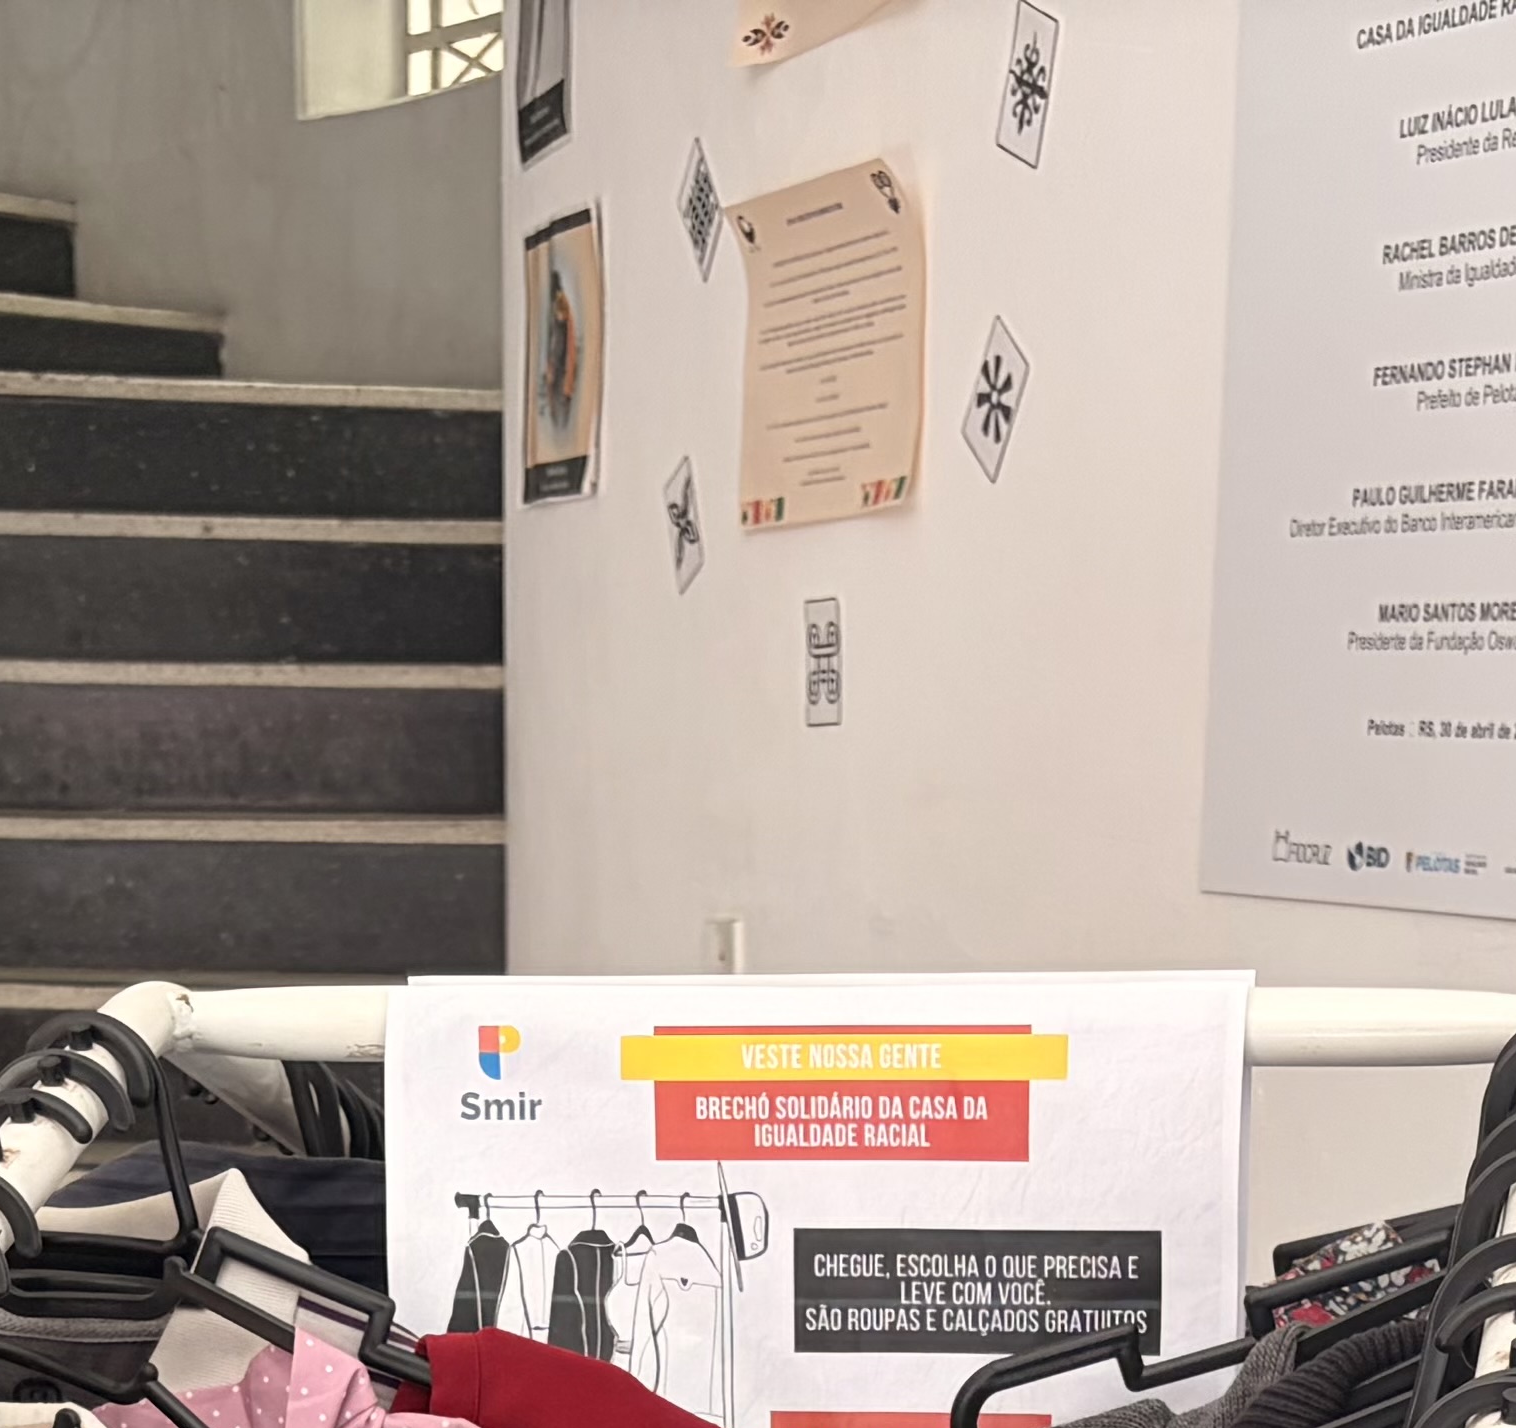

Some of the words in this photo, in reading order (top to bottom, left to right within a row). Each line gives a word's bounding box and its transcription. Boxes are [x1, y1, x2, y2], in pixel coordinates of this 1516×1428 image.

[1357, 23, 1394, 49] CASA
[1396, 18, 1415, 40] DA
[1418, 0, 1498, 35] IGUALDADE
[1399, 114, 1430, 138] LUIZ
[1431, 104, 1479, 133] INÁCIO
[1416, 136, 1480, 165] Presidente
[1484, 132, 1499, 153] da
[1382, 238, 1435, 265] RACHEL
[1438, 228, 1496, 256] BARROS
[1399, 268, 1444, 291] Ministra
[1446, 265, 1461, 285] da
[1373, 360, 1445, 387] FERNANDO
[1447, 353, 1512, 379] STEPHAN
[1416, 388, 1462, 411] Prefeito
[1464, 386, 1480, 407] de
[1352, 486, 1397, 508] PAULO
[1398, 481, 1475, 505] GUILHERME
[1289, 518, 1326, 538] Diretor
[1328, 516, 1381, 537] Executivo
[1384, 515, 1398, 534] do
[1400, 513, 1437, 533] Banco
[1378, 602, 1420, 623] MARIO
[1422, 601, 1476, 622] SANTOS
[1347, 631, 1406, 651] Presidente
[1409, 631, 1424, 651] da
[1426, 630, 1485, 655] Fundação
[741, 1043, 804, 1070] VESTE
[808, 1043, 874, 1070] NOSSA
[879, 1042, 943, 1069] GENTE
[459, 1091, 543, 1121] Smir
[695, 1092, 770, 1120] BRECHÓ
[775, 1091, 874, 1120] SOLIDÁRIO
[878, 1096, 903, 1120] DA
[908, 1095, 959, 1120] CASA
[963, 1095, 989, 1120] DA
[754, 1123, 859, 1148] IGUALDADE
[864, 1123, 931, 1148] RACIAL
[813, 1253, 891, 1280] CHEGUE,
[896, 1254, 980, 1279] ESCOLHA
[985, 1254, 998, 1279] O
[1002, 1255, 1038, 1279] QUE
[1044, 1255, 1122, 1280] PRECISA
[1128, 1256, 1140, 1280] E
[899, 1281, 947, 1305] LEVE
[952, 1281, 992, 1305] COM
[996, 1278, 1051, 1306] VOCÊ.
[805, 1304, 842, 1332] SÃO
[847, 1308, 921, 1332] ROUPAS
[926, 1308, 937, 1332] E
[942, 1308, 1040, 1337] CALÇADOS
